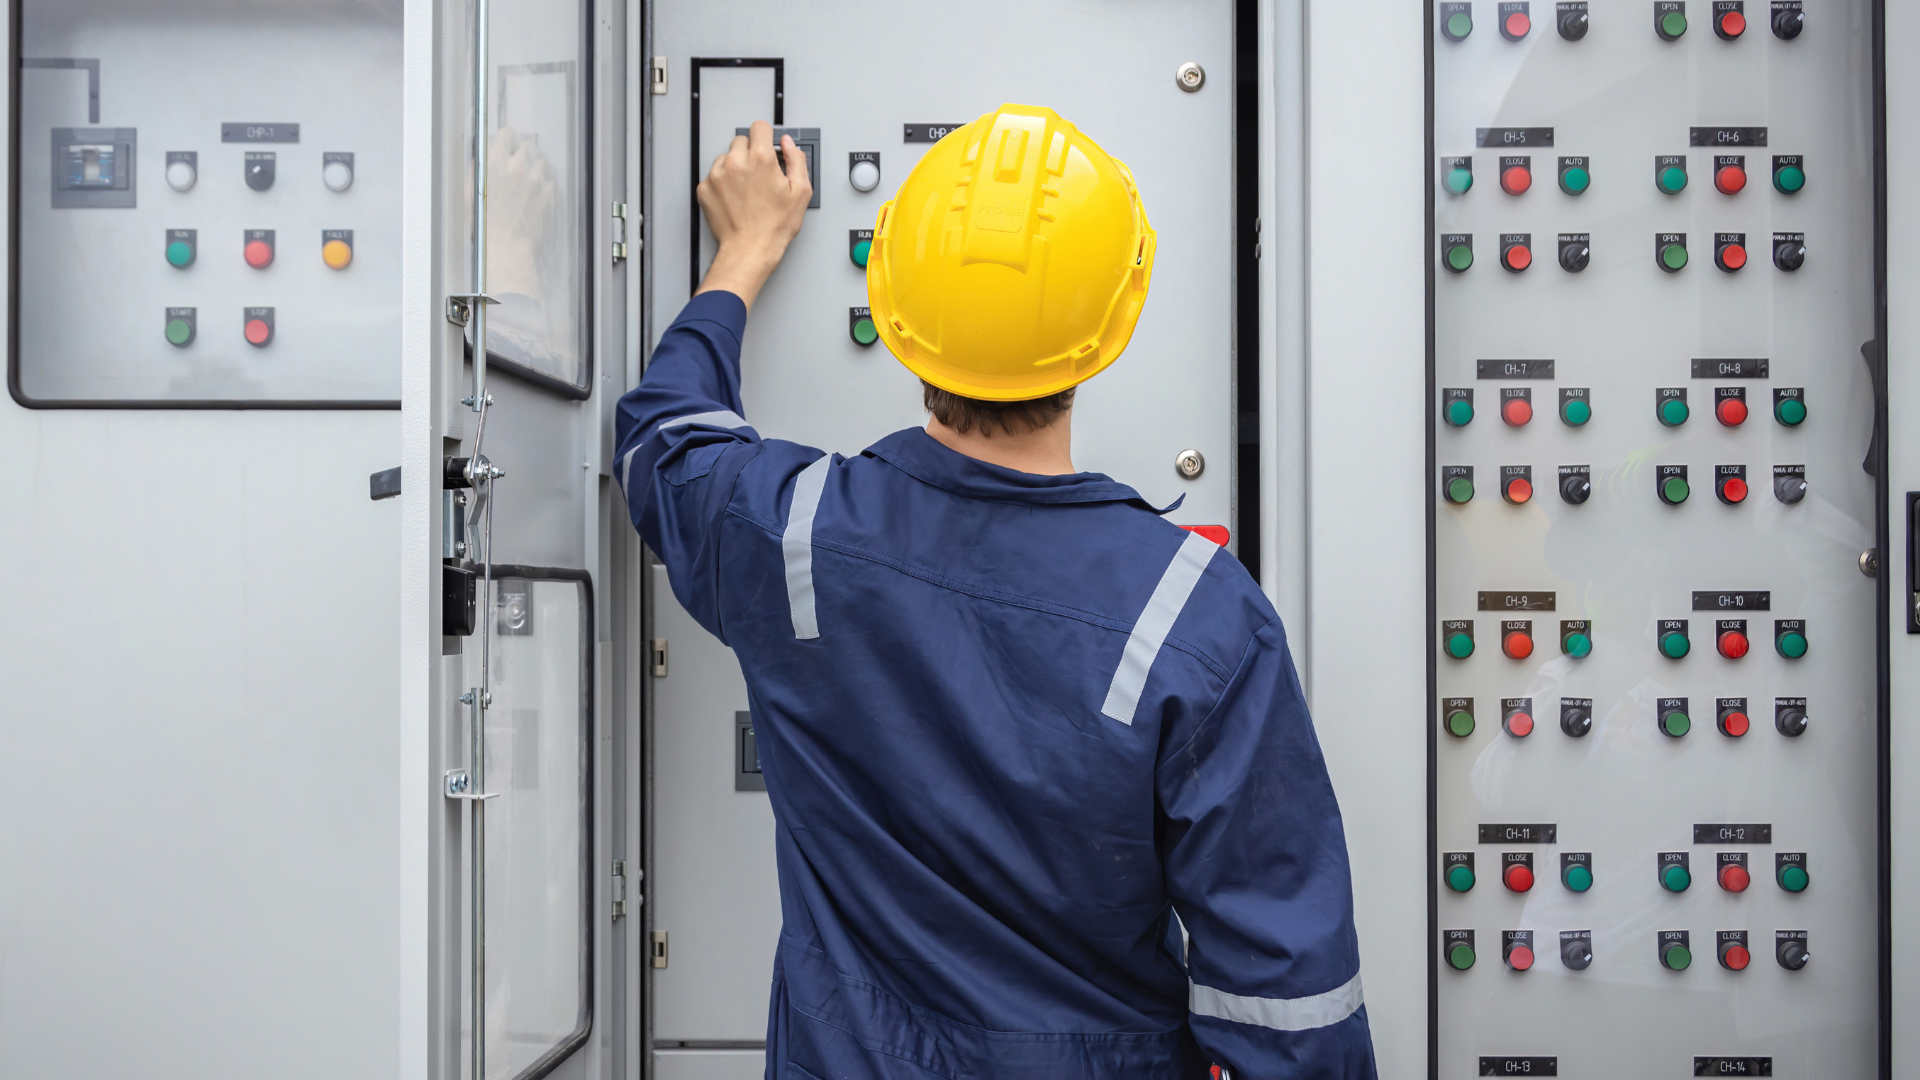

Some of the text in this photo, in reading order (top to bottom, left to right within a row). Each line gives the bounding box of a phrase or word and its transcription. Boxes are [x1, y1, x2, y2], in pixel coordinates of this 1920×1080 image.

[1504, 3, 1523, 11] CLOSE
[1718, 2, 1737, 10] CLOSE
[246, 127, 275, 139] CHP-1
[928, 127, 956, 139] CHP
[1717, 131, 1739, 142] CH-6
[1504, 132, 1526, 143] CH-5
[854, 153, 874, 161] LOCAL
[1505, 157, 1524, 165] CLOSE
[1506, 235, 1525, 243] CLOSE
[1662, 234, 1679, 242] OPEN
[1720, 234, 1739, 242] CLOSE
[250, 308, 268, 316] STOP
[854, 308, 871, 316] STAR
[1504, 363, 1527, 375] CH-7
[1719, 363, 1741, 374] CH-8
[1450, 389, 1467, 397] OPEN
[1506, 389, 1525, 397] CLOSE
[1566, 389, 1583, 397] AUTO
[1720, 388, 1740, 396] CLOSE
[1780, 389, 1798, 397] AUTO
[1450, 467, 1466, 475] OPEN
[1721, 466, 1740, 474] CLOSE
[1505, 595, 1528, 607] CH-9
[1718, 595, 1744, 607] CH-10
[1450, 621, 1467, 629] OPEN
[1507, 621, 1526, 629] CLOSE
[1567, 621, 1585, 629] AUTO
[1664, 621, 1681, 629] OPEN
[1722, 621, 1741, 629] CLOSE
[1781, 621, 1799, 629] AUTO
[1450, 699, 1467, 707] OPEN
[1507, 699, 1526, 707] CLOSE
[1664, 699, 1681, 707] OPEN
[1722, 699, 1741, 707] CLOSE
[1506, 828, 1530, 840] CH-11
[1719, 828, 1745, 840] CH-12
[1450, 853, 1467, 861] OPEN
[1508, 853, 1527, 861] CLOSE
[1665, 853, 1682, 861] OPEN
[1722, 853, 1742, 861] CLOSE
[1451, 931, 1468, 939] OPEN
[1508, 931, 1527, 939] CLOSE
[1665, 932, 1682, 940] OPEN
[1722, 932, 1742, 940] CLOSE
[1505, 1060, 1531, 1072] CH-13
[1720, 1061, 1746, 1072] CH-14
